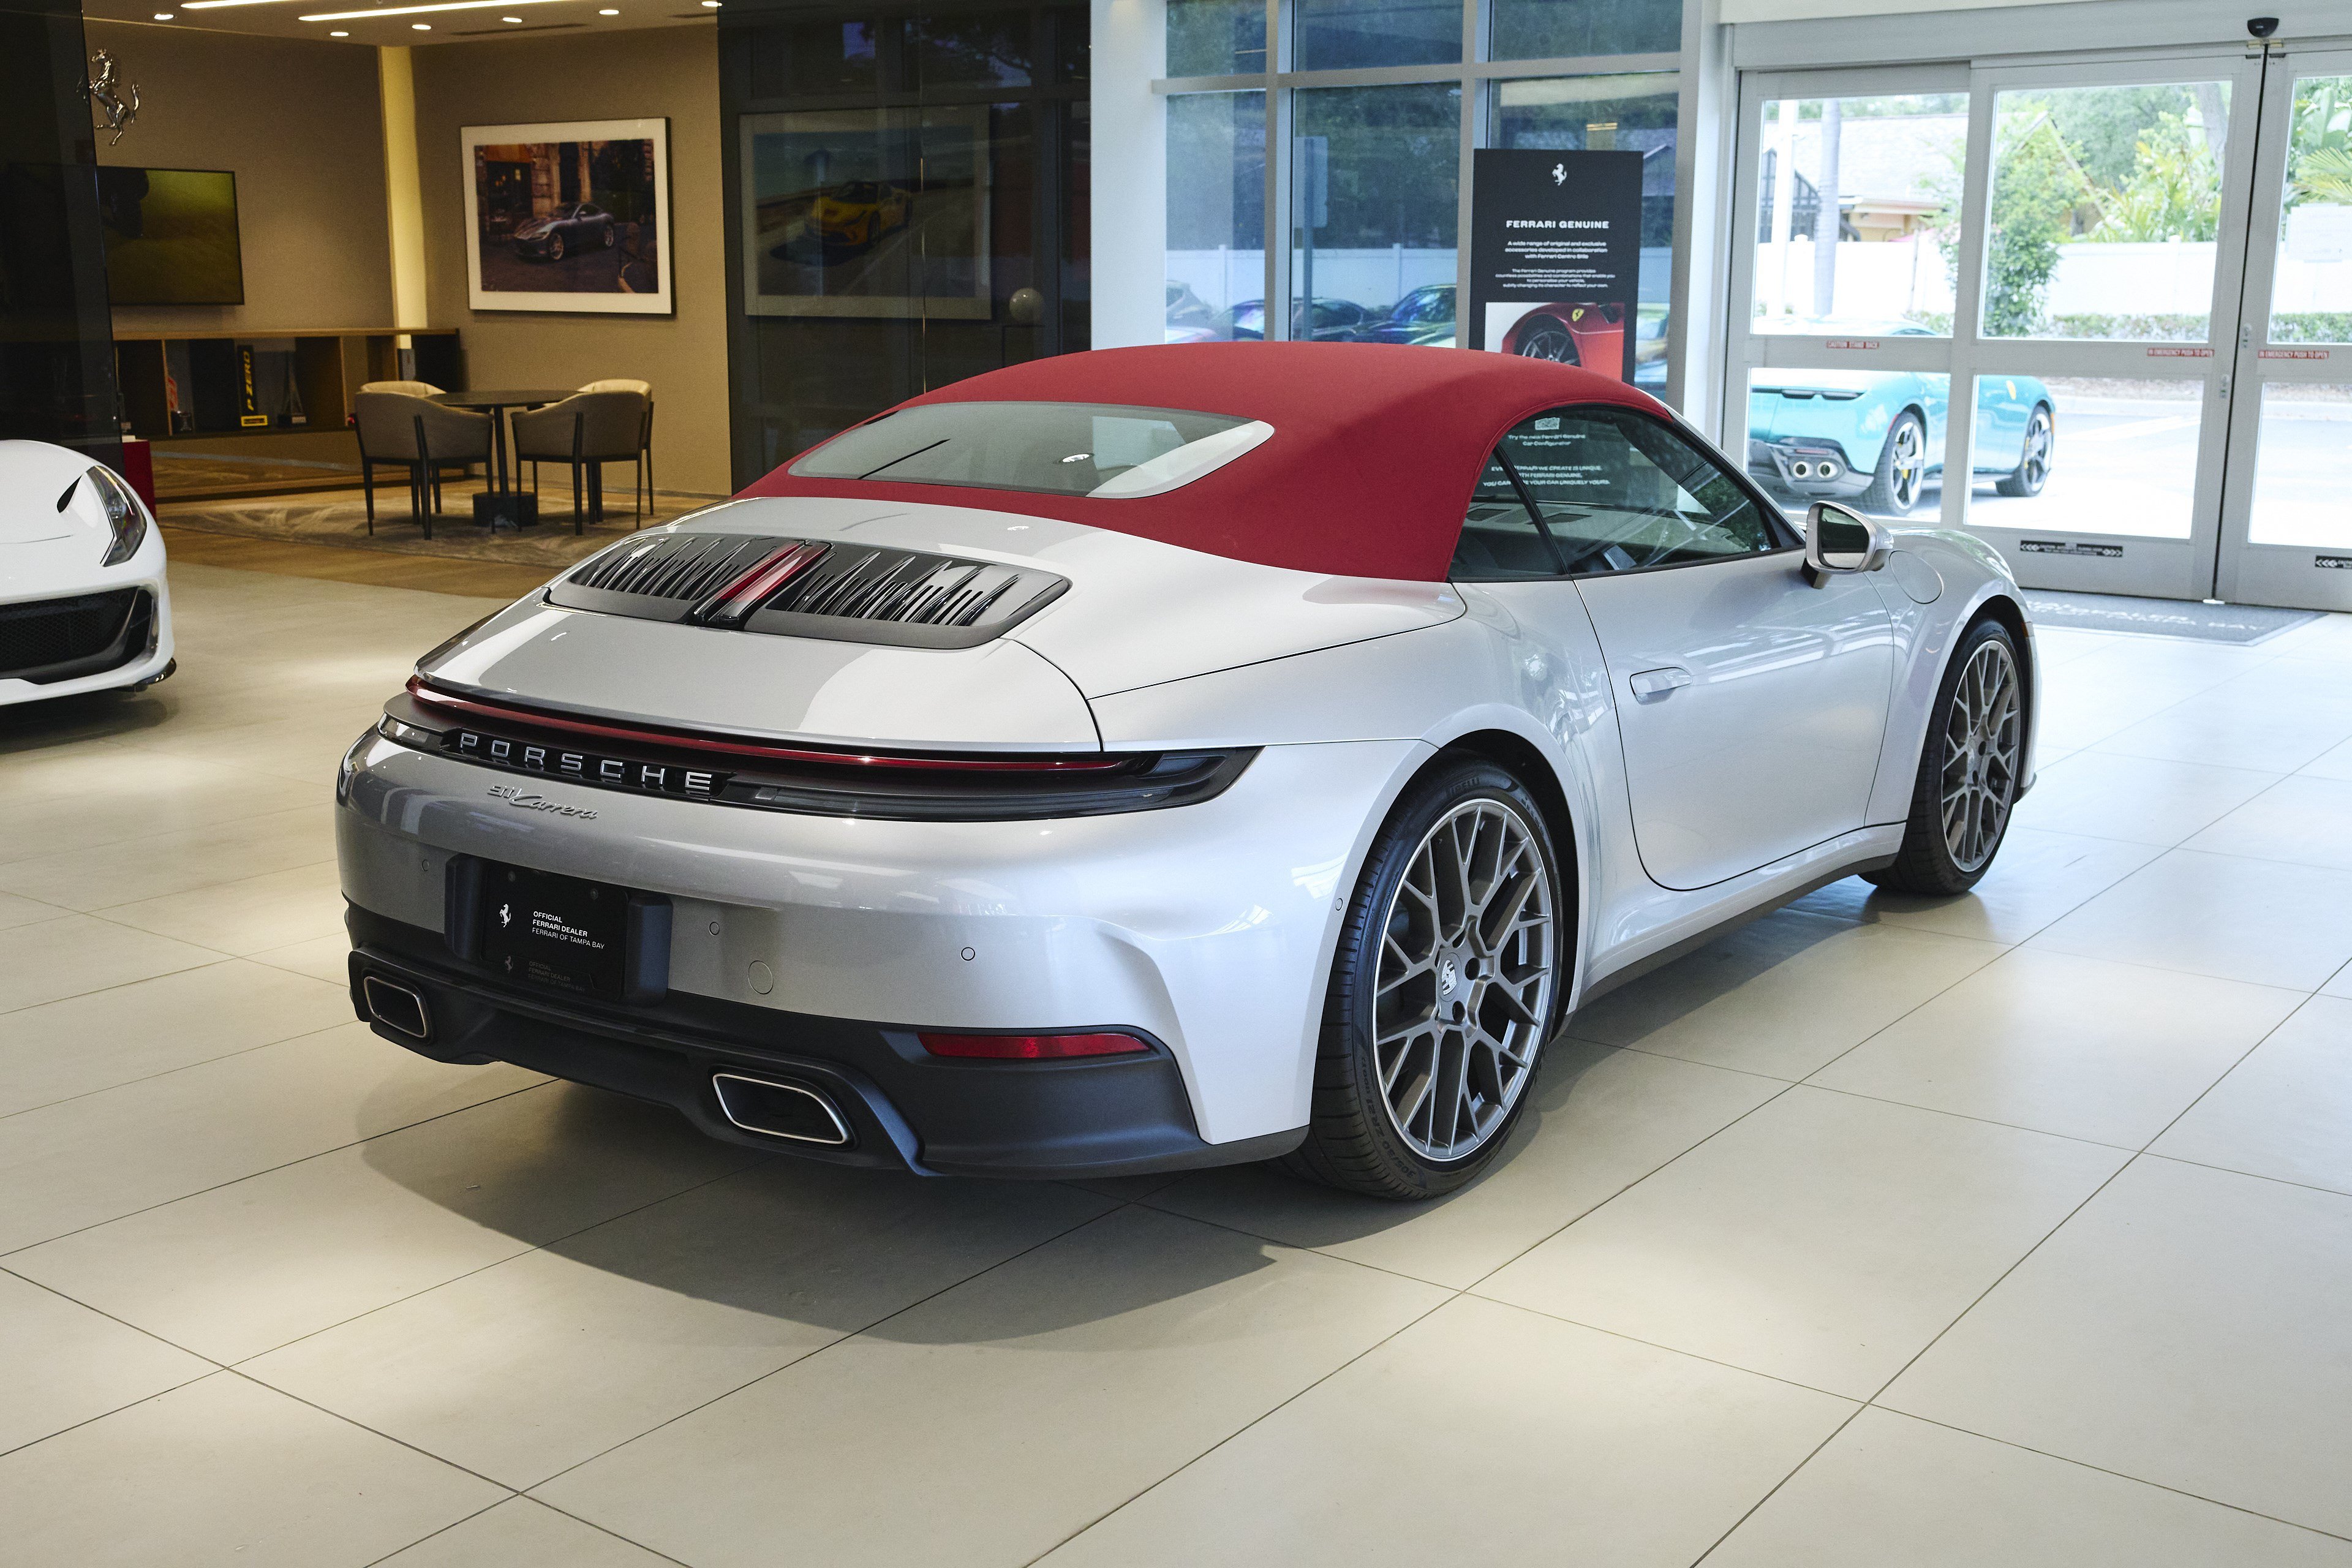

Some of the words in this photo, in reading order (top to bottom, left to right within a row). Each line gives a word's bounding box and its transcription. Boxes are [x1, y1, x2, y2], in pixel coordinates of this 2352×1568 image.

[459, 733, 712, 791] PORSCHE
[508, 794, 598, 820] Carrera
[532, 919, 560, 931] FERRARI
[561, 925, 588, 937] DEALER
[533, 911, 562, 923] OFFICIAL
[532, 927, 558, 939] FERRARI
[570, 936, 590, 946] TAMPA
[592, 941, 605, 949] BAY
